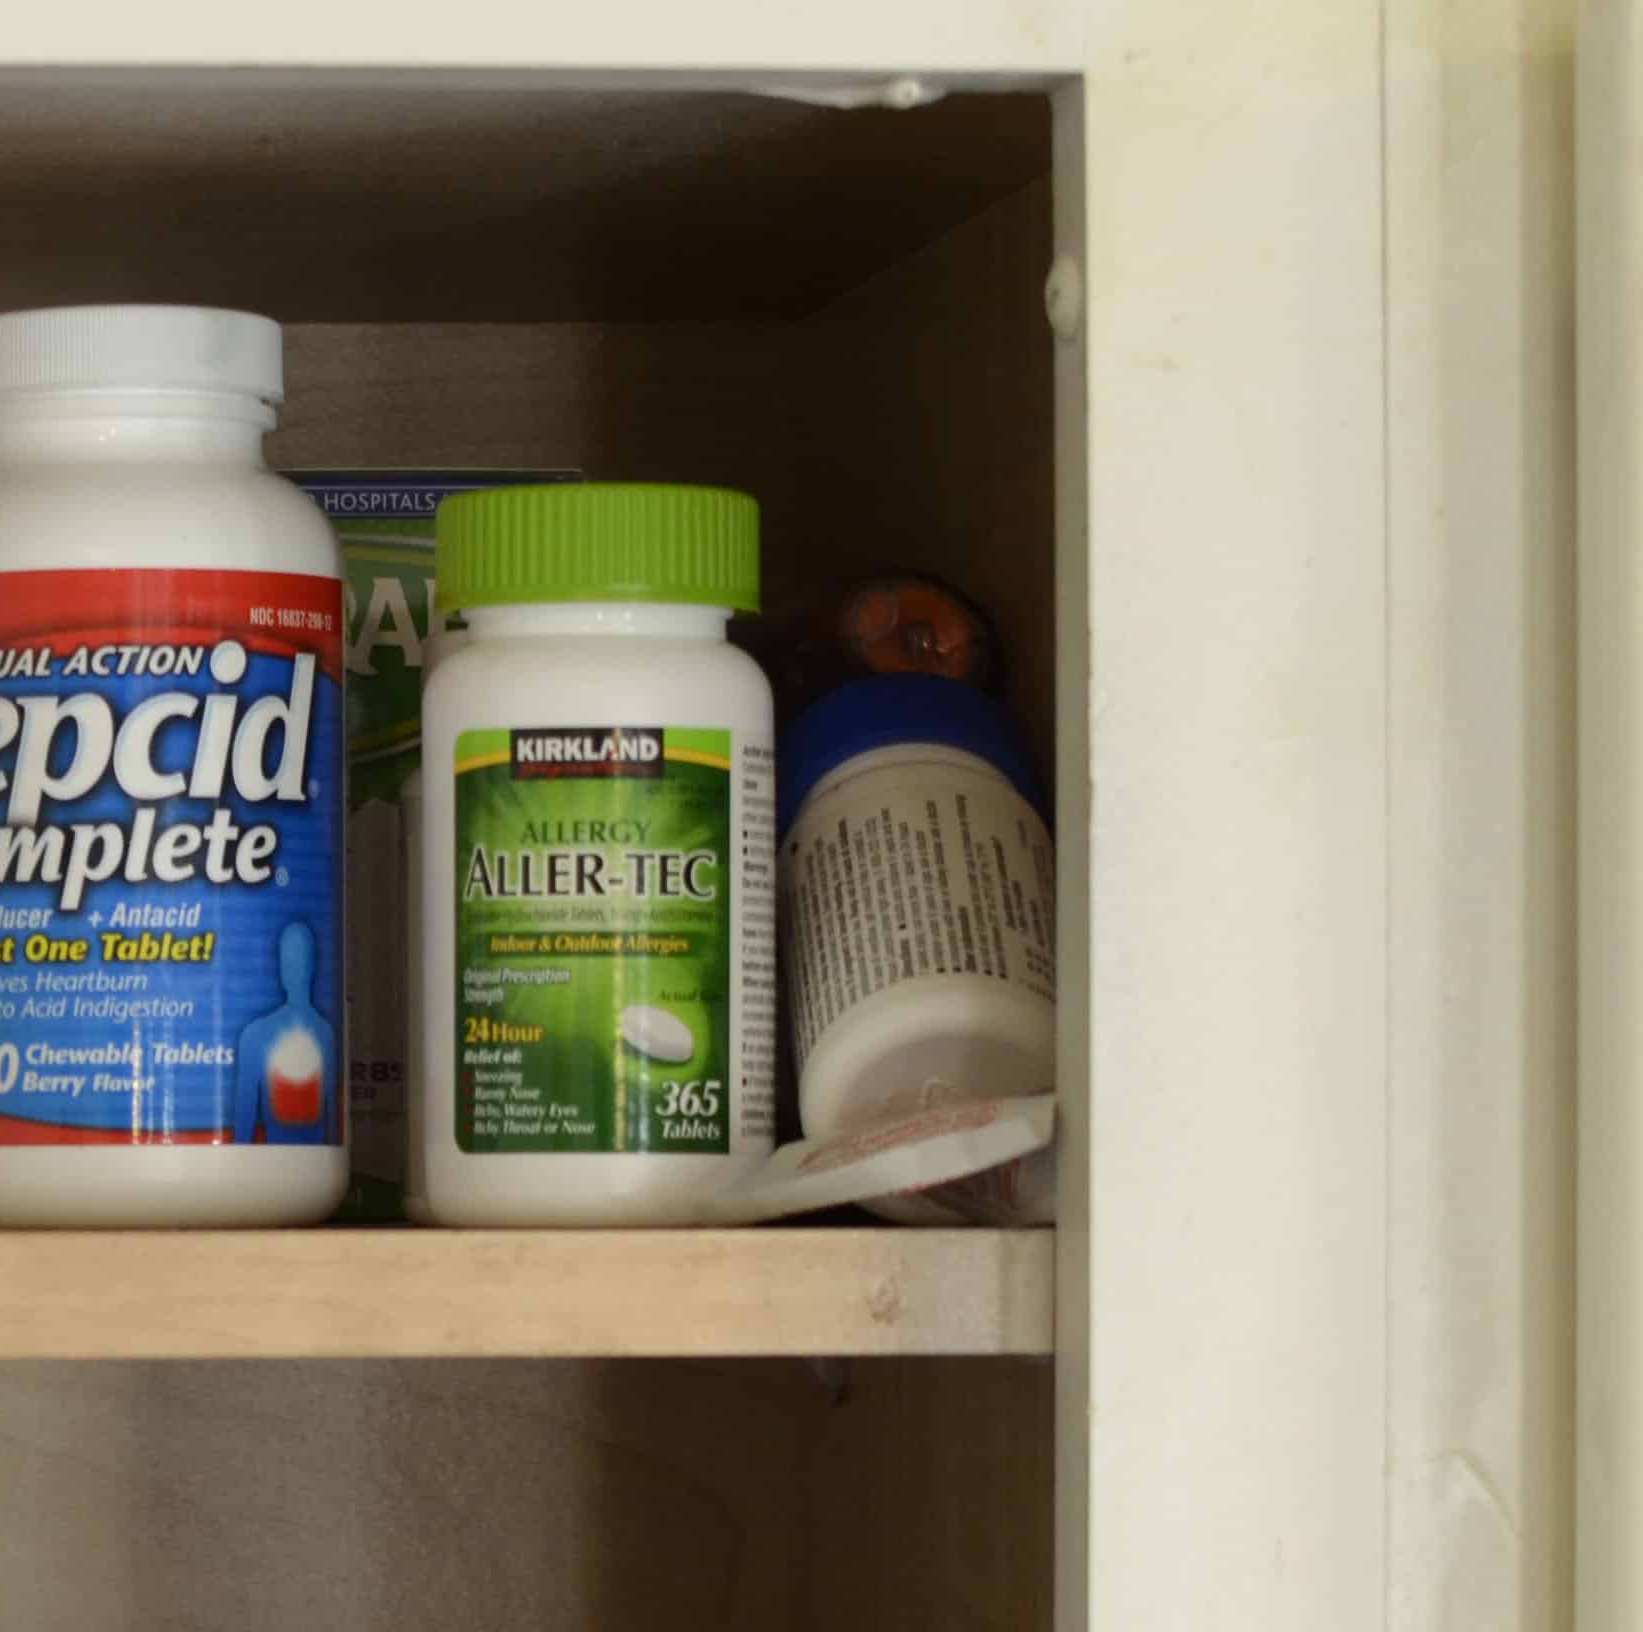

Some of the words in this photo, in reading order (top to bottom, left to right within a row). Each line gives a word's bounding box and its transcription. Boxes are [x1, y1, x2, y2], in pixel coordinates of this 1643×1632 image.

[323, 491, 437, 512] HOSPITALS
[62, 643, 204, 676] ACTION
[517, 735, 660, 763] KIRKLAND
[520, 819, 652, 845] ALLERGY
[465, 846, 717, 900] ALLER-TEC
[89, 910, 103, 926] +
[109, 902, 202, 930] Antacid
[24, 934, 89, 962] One
[101, 931, 215, 962] Tablet!
[491, 934, 536, 953] Indoor
[539, 935, 553, 953] &
[555, 934, 621, 953] Outdoor
[626, 934, 688, 954] Allergies
[35, 970, 149, 992] Heartburn
[22, 998, 65, 1018] Acid
[73, 997, 195, 1023] Indigestion
[464, 1016, 491, 1043] 24
[492, 1022, 544, 1043] Hour
[25, 1043, 144, 1067] Chewable
[151, 1043, 235, 1067] Tablets
[464, 1050, 499, 1064] Relief
[23, 1071, 87, 1096] Berry
[93, 1073, 156, 1093] Flavor
[509, 1086, 541, 1101] Nose
[504, 1103, 546, 1120] Watery
[549, 1103, 579, 1119] Eyes
[655, 1080, 722, 1118] 365
[544, 1122, 558, 1136] or
[561, 1120, 596, 1136] Nose
[660, 1119, 722, 1141] Tablets
